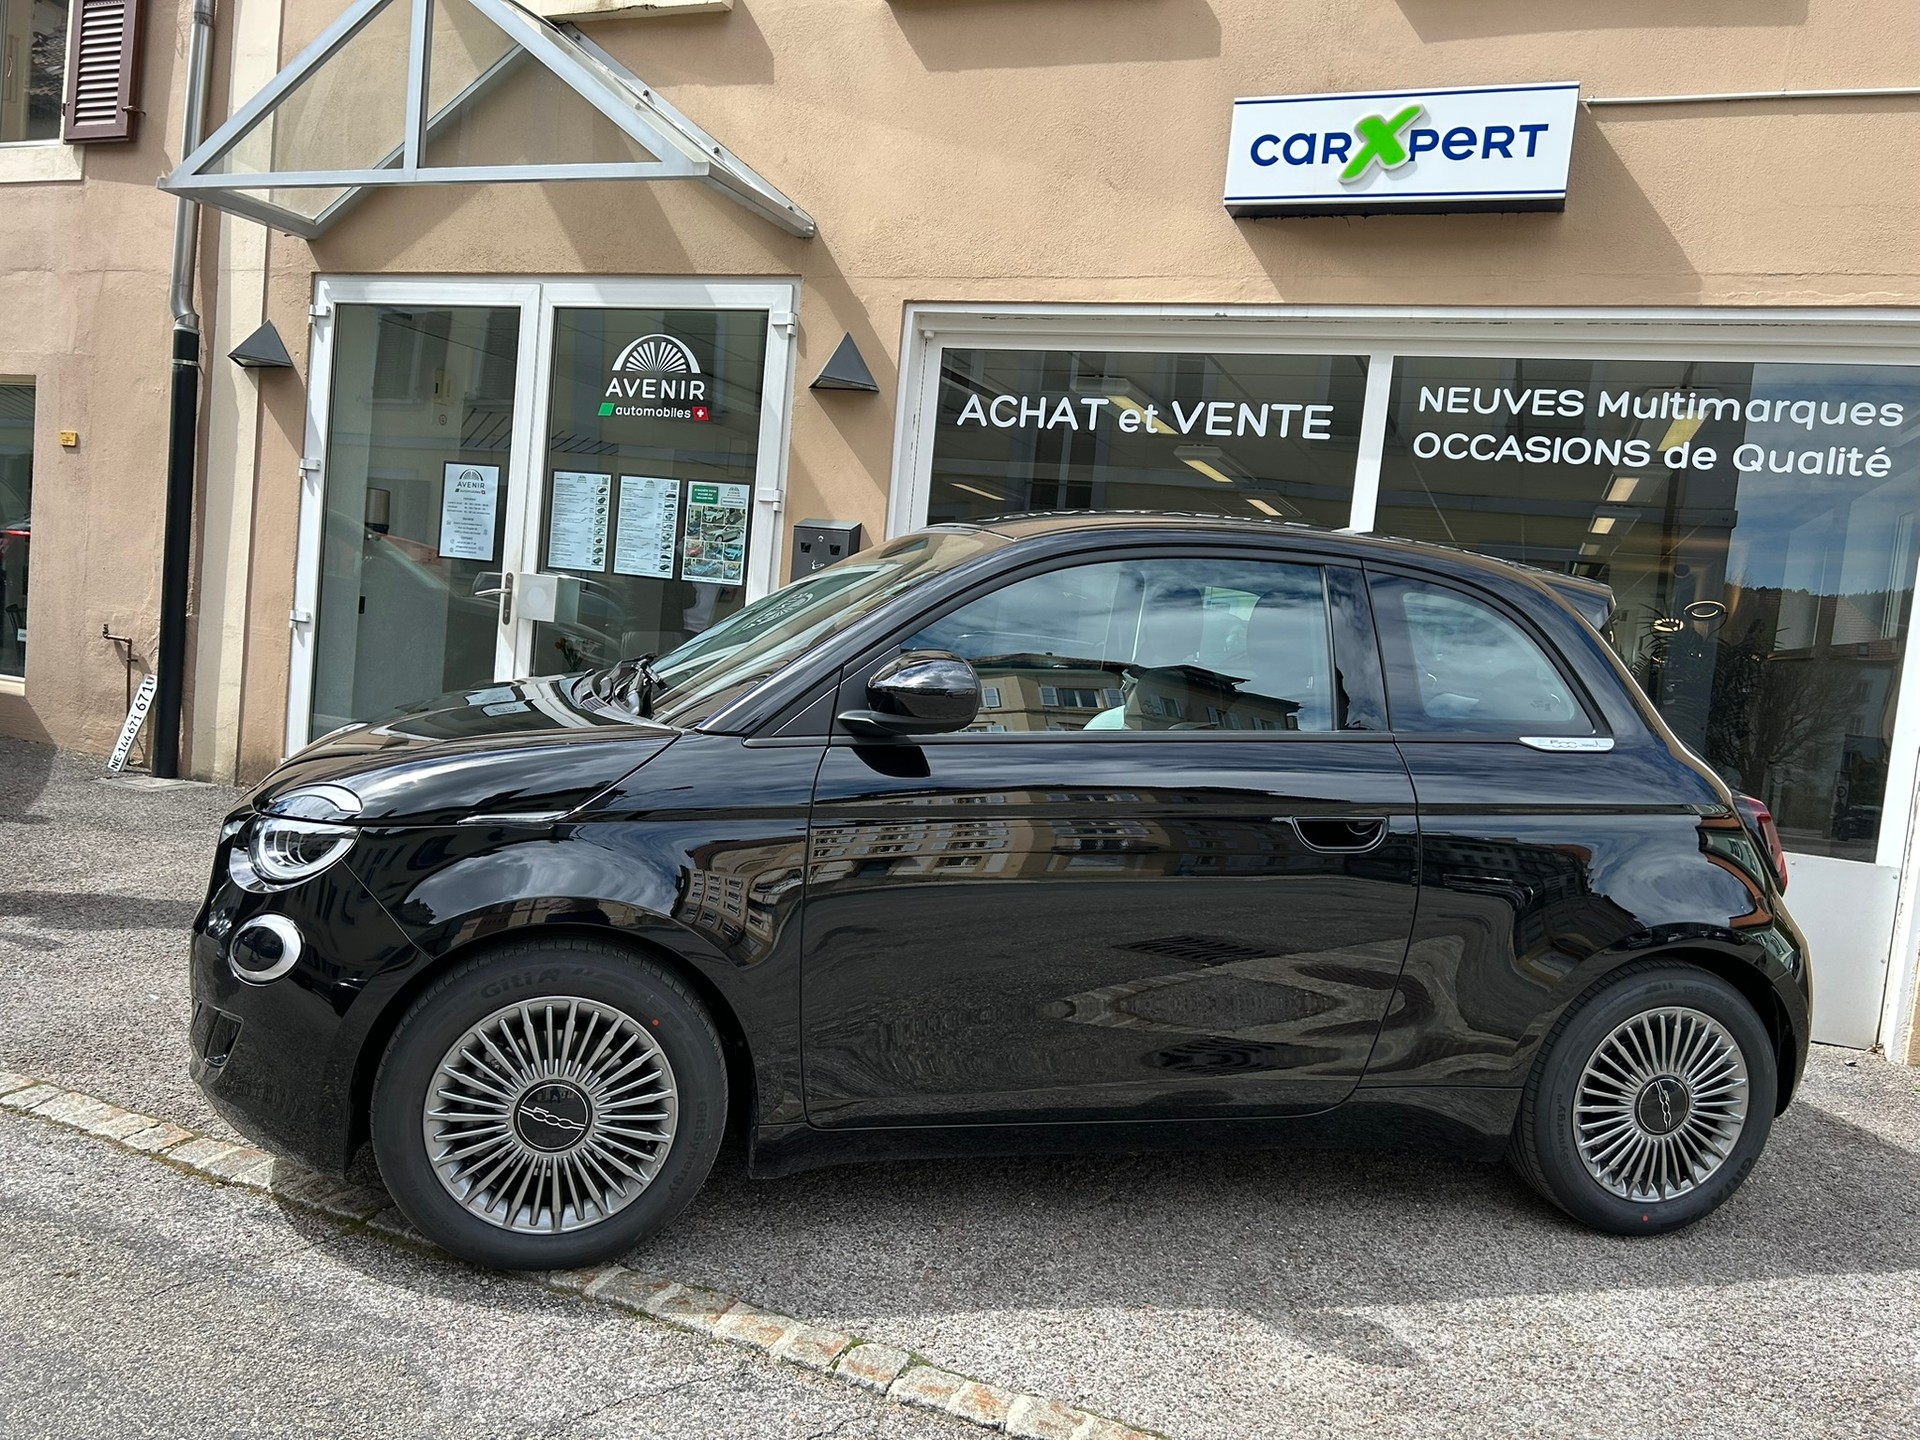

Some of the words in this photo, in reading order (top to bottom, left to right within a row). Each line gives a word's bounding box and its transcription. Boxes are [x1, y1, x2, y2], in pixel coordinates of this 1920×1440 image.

[605, 377, 705, 400] AVENIR
[615, 405, 691, 419] automobiles
[956, 393, 1109, 431] ACHAT
[1118, 403, 1158, 434] et
[1171, 400, 1334, 440] VENTE
[1418, 386, 1585, 417] NEUVES
[1597, 390, 1904, 430] Multimarques
[1413, 431, 1651, 468] OCCASIONS
[1664, 441, 1717, 471] de
[1733, 443, 1892, 478] Qualité
[456, 481, 485, 489] AVENIR
[480, 972, 534, 999] Giti
